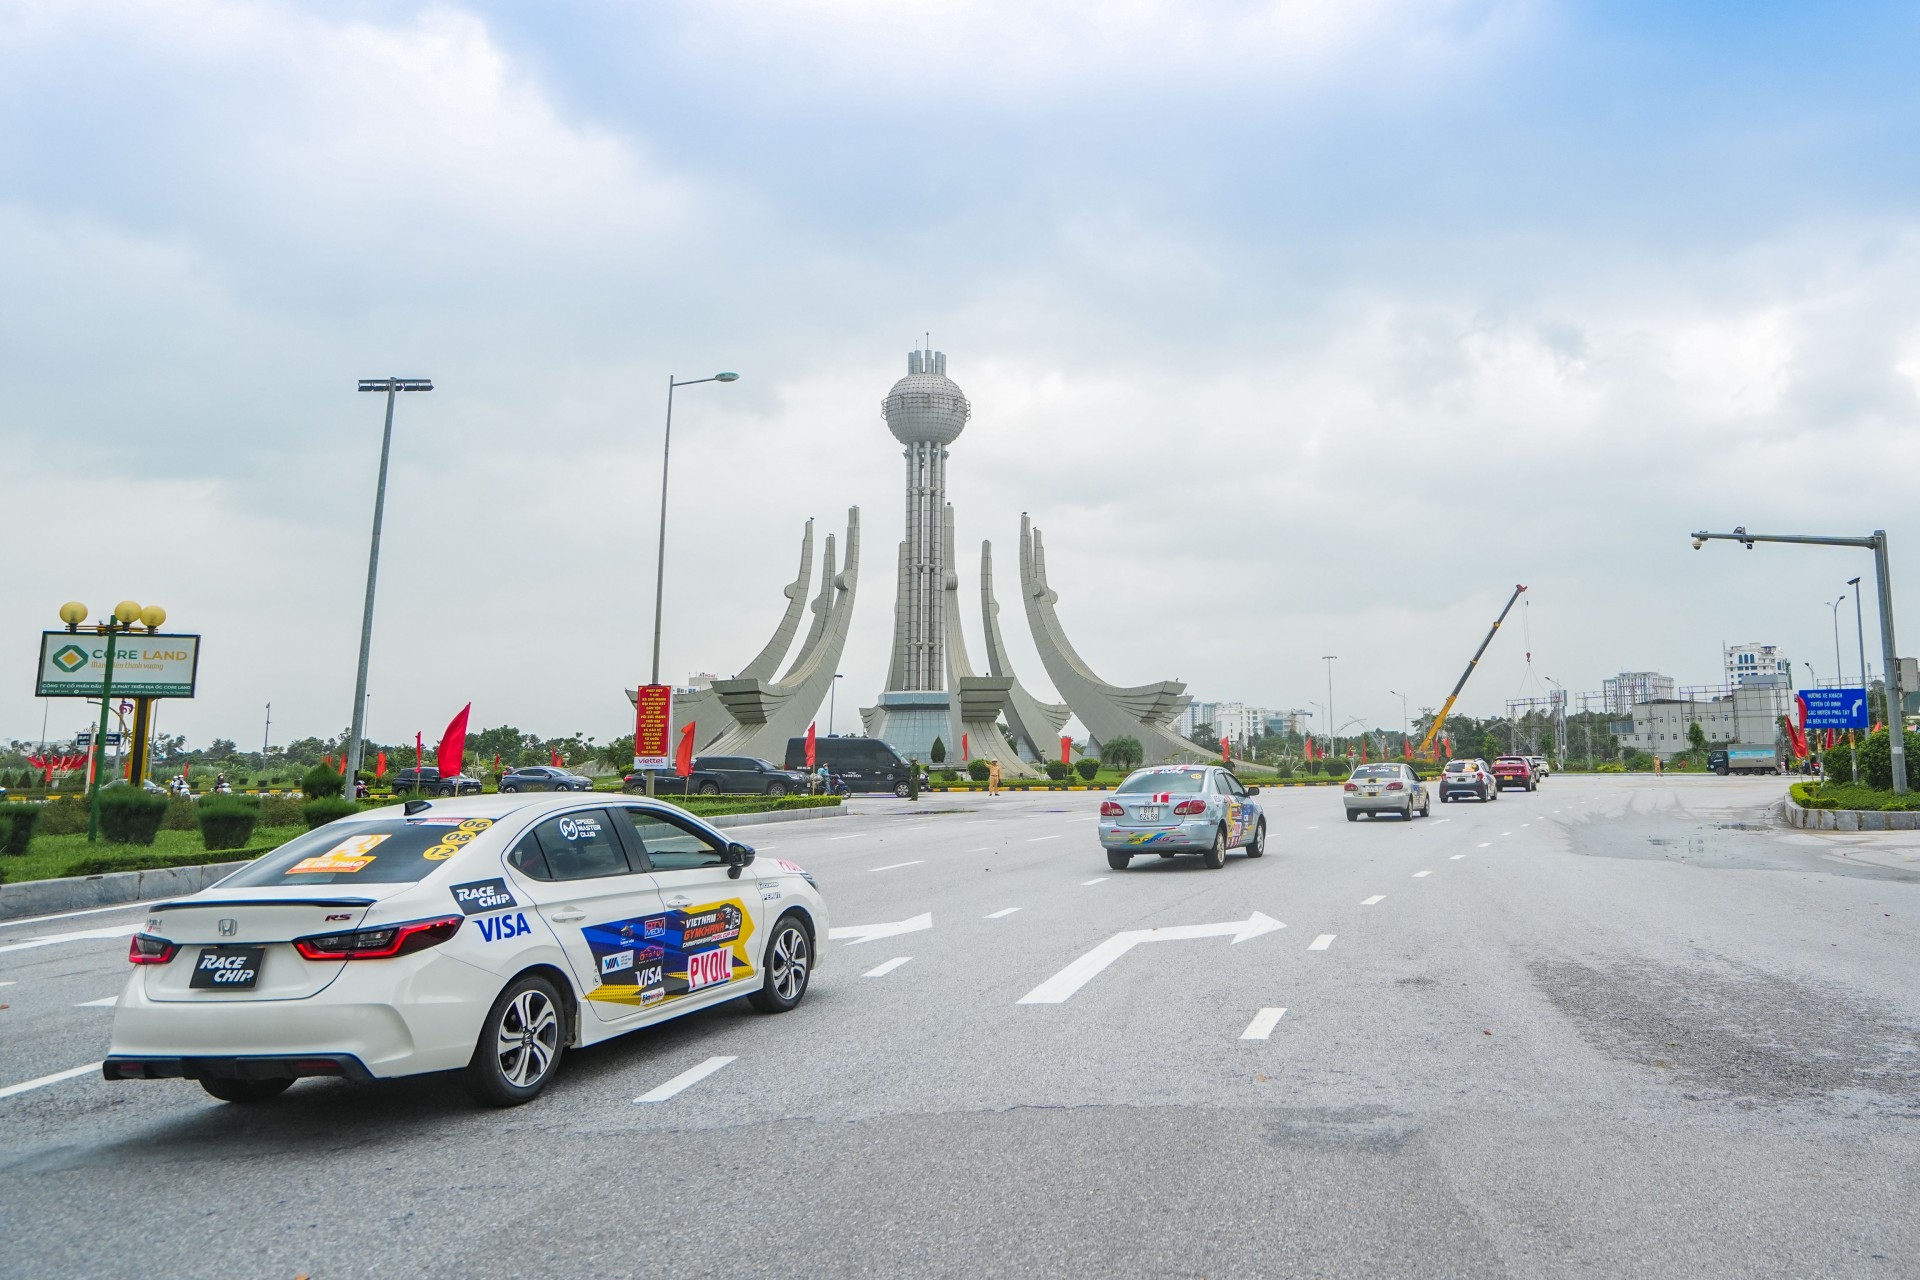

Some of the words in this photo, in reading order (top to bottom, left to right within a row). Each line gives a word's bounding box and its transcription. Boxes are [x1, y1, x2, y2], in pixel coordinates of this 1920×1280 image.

[142, 650, 188, 660] LAND
[446, 833, 472, 842] 08
[430, 847, 454, 856] 12
[456, 886, 494, 902] RACE
[478, 894, 510, 907] CHIP
[324, 913, 352, 921] RS
[686, 914, 716, 928] VIETNAM
[472, 912, 532, 942] VISA
[684, 922, 725, 941] GYMKHANA
[200, 954, 248, 970] RACE
[691, 949, 731, 988] PVOIL
[214, 970, 255, 982] CHIP
[634, 966, 662, 987] VISA
